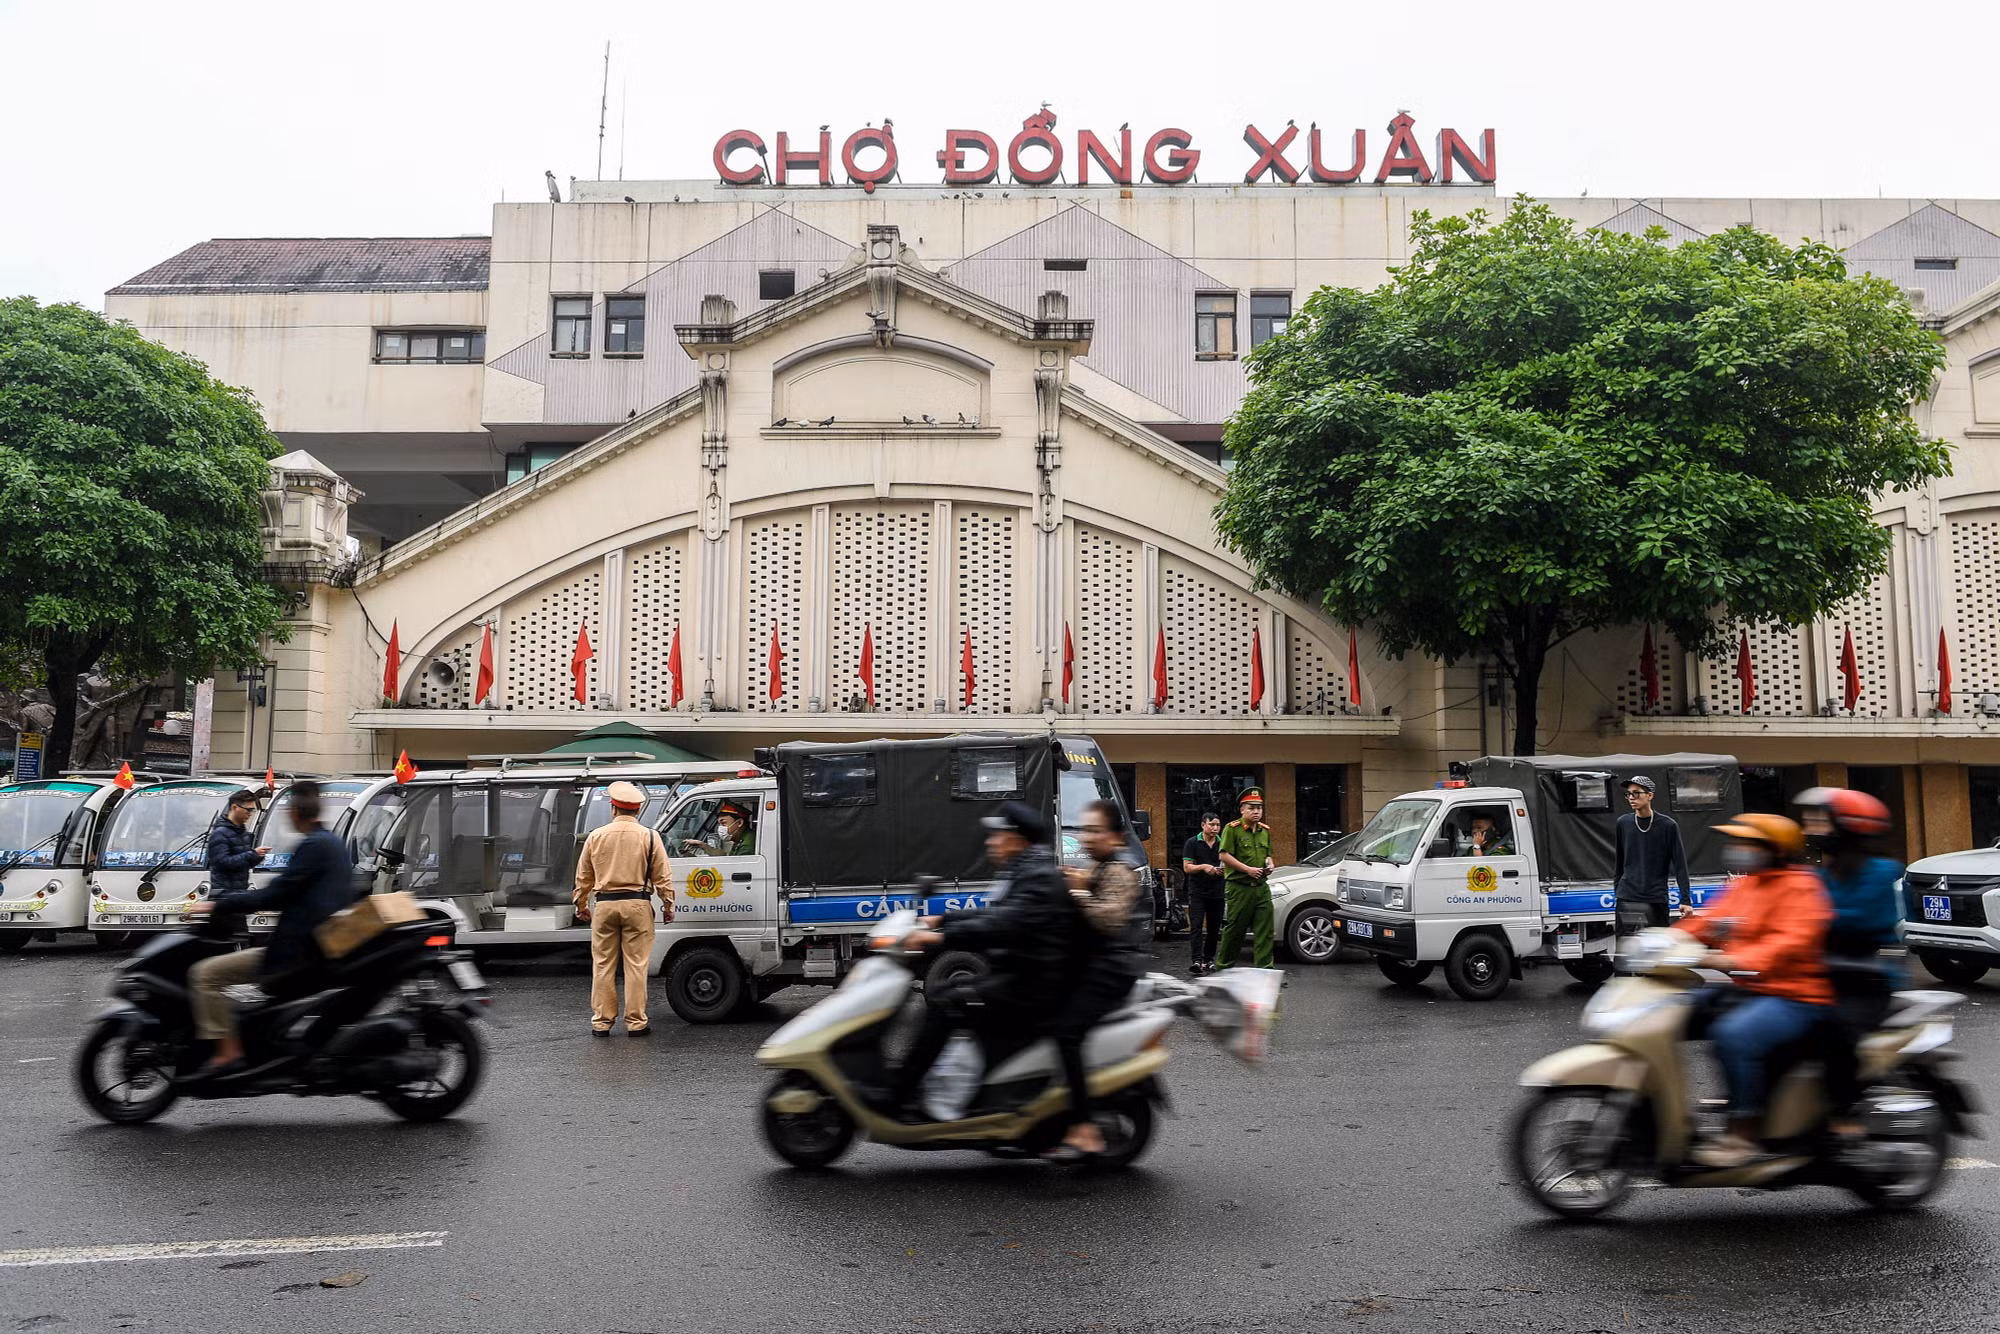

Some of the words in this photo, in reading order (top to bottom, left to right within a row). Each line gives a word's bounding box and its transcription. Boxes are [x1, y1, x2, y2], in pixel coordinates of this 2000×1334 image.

[713, 124, 898, 194] CHỢ
[936, 107, 1202, 185] ĐỒNG
[1243, 112, 1497, 184] XUÂN
[1446, 894, 1471, 904] CÔNG
[1473, 896, 1485, 904] AN
[1487, 894, 1522, 904] PHƯỜNG
[1929, 897, 1944, 908] 29A
[692, 904, 707, 913] AN
[709, 902, 753, 913] PHƯỜNG
